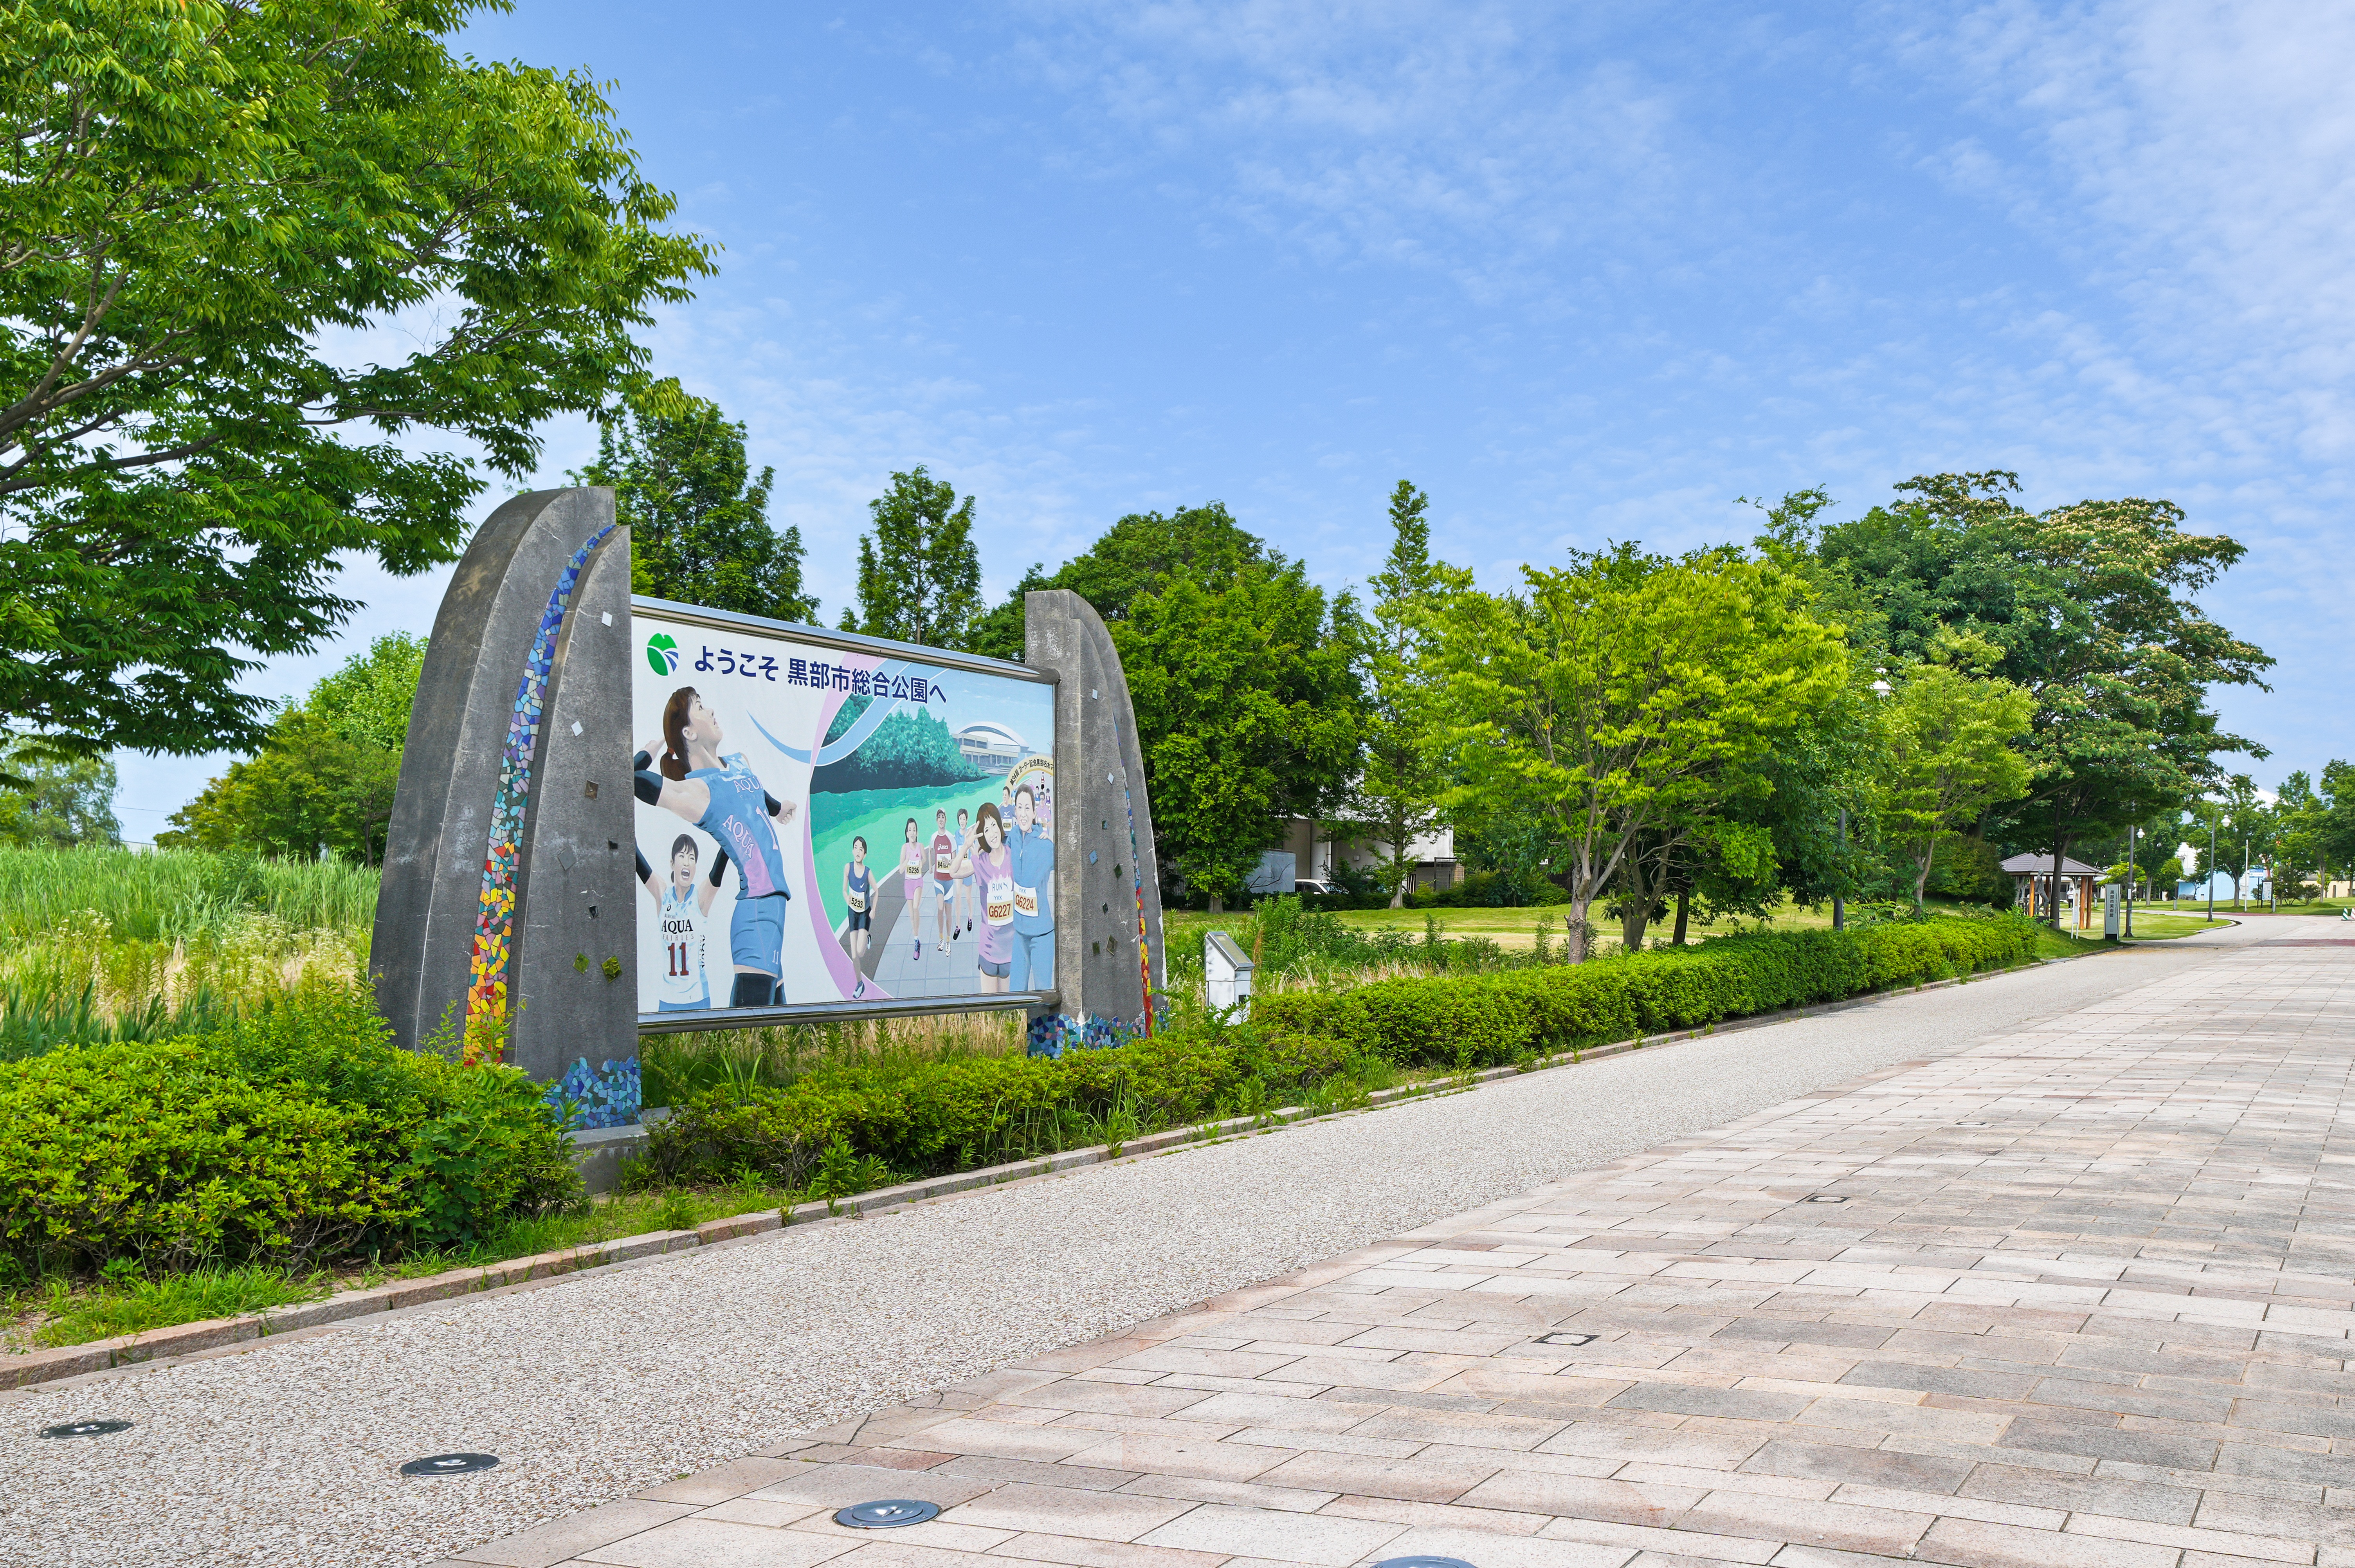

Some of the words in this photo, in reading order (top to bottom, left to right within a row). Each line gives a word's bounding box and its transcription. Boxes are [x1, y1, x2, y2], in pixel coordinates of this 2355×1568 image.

[695, 645, 778, 681] ようこそ
[787, 658, 947, 704] 黒部市総合公園へ
[722, 815, 754, 858] AQUA
[992, 883, 1003, 892] RUN
[851, 898, 863, 908] 5233
[1016, 895, 1034, 910] G6224
[989, 903, 1011, 918] G6227
[661, 919, 693, 934] AQUA
[668, 943, 689, 976] 11
[772, 949, 779, 964] 11
